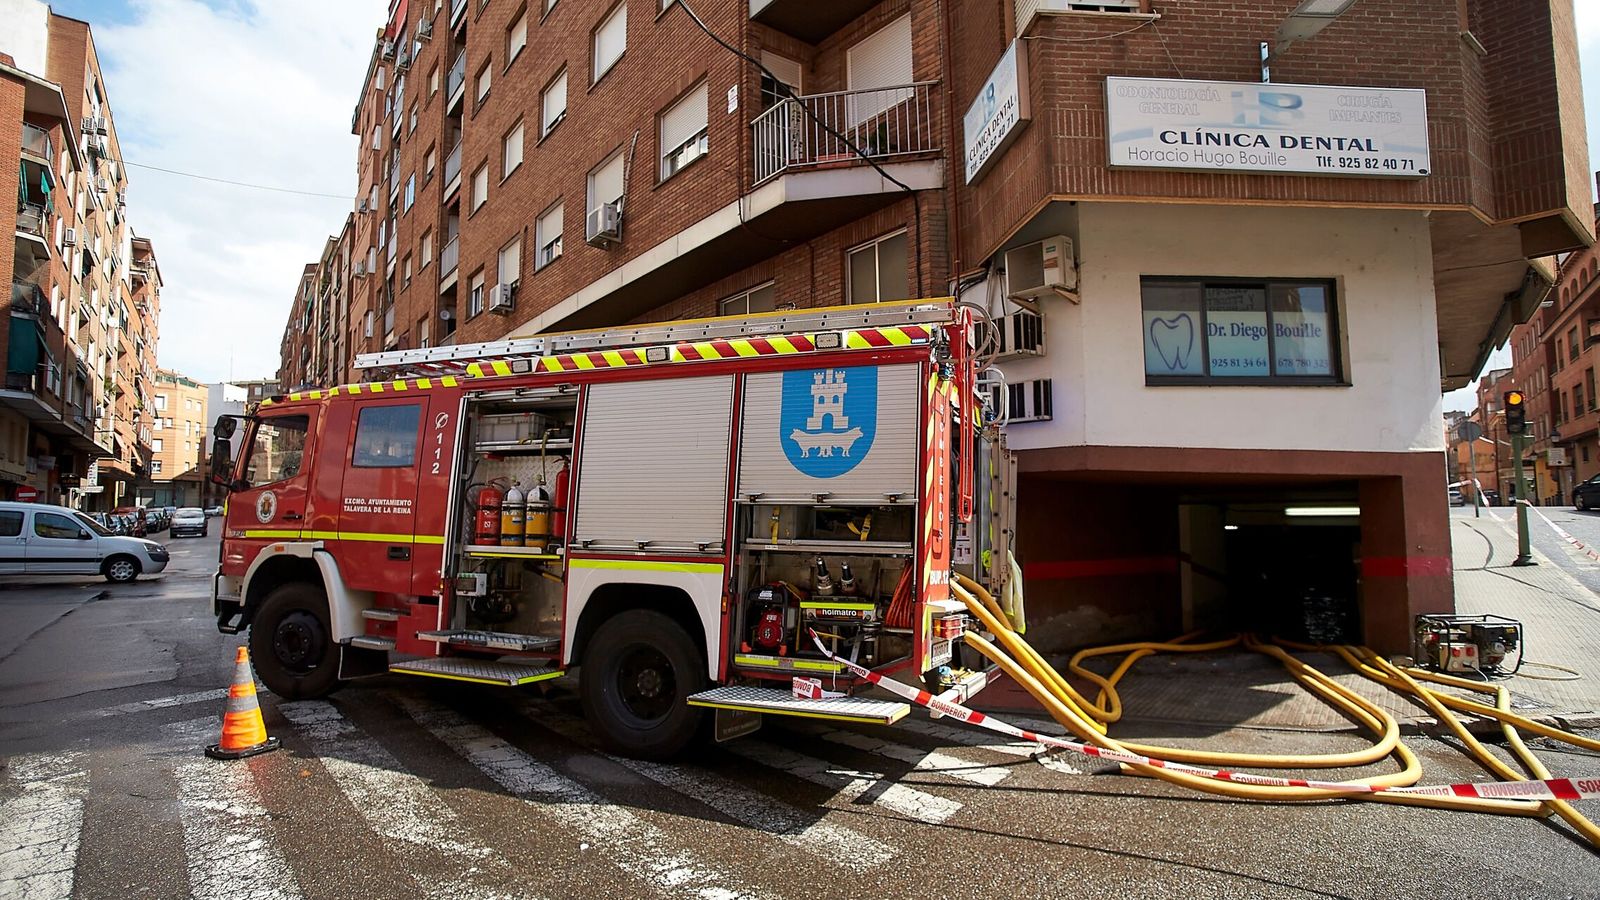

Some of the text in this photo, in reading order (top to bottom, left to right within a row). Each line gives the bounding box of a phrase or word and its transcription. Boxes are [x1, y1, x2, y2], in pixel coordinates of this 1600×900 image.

[1116, 85, 1221, 102] ODONTOLOGÍA
[1337, 93, 1393, 109] CIRUGÍA
[992, 96, 1014, 132] DENTAL
[1138, 102, 1201, 116] GENERAL
[1329, 109, 1402, 124] IMPLANTES
[1160, 128, 1379, 152] CLÍNICA DENTAL
[1128, 147, 1287, 167] Horacio Hugo Bouille
[1316, 155, 1414, 171] Tlf. 925 82 40 71
[1208, 322, 1321, 341] Dr. Diego Bouille
[1212, 358, 1228, 368] 925
[1230, 358, 1240, 367] 81
[1243, 359, 1254, 368] 34
[1278, 359, 1293, 368] 678
[1295, 359, 1311, 368] 780
[343, 505, 372, 513] TALAVERA
[344, 498, 412, 507] EXCMO. AYUNTAMIENTO
[822, 608, 857, 617] holmatro
[930, 699, 968, 720] BOMBEROS
